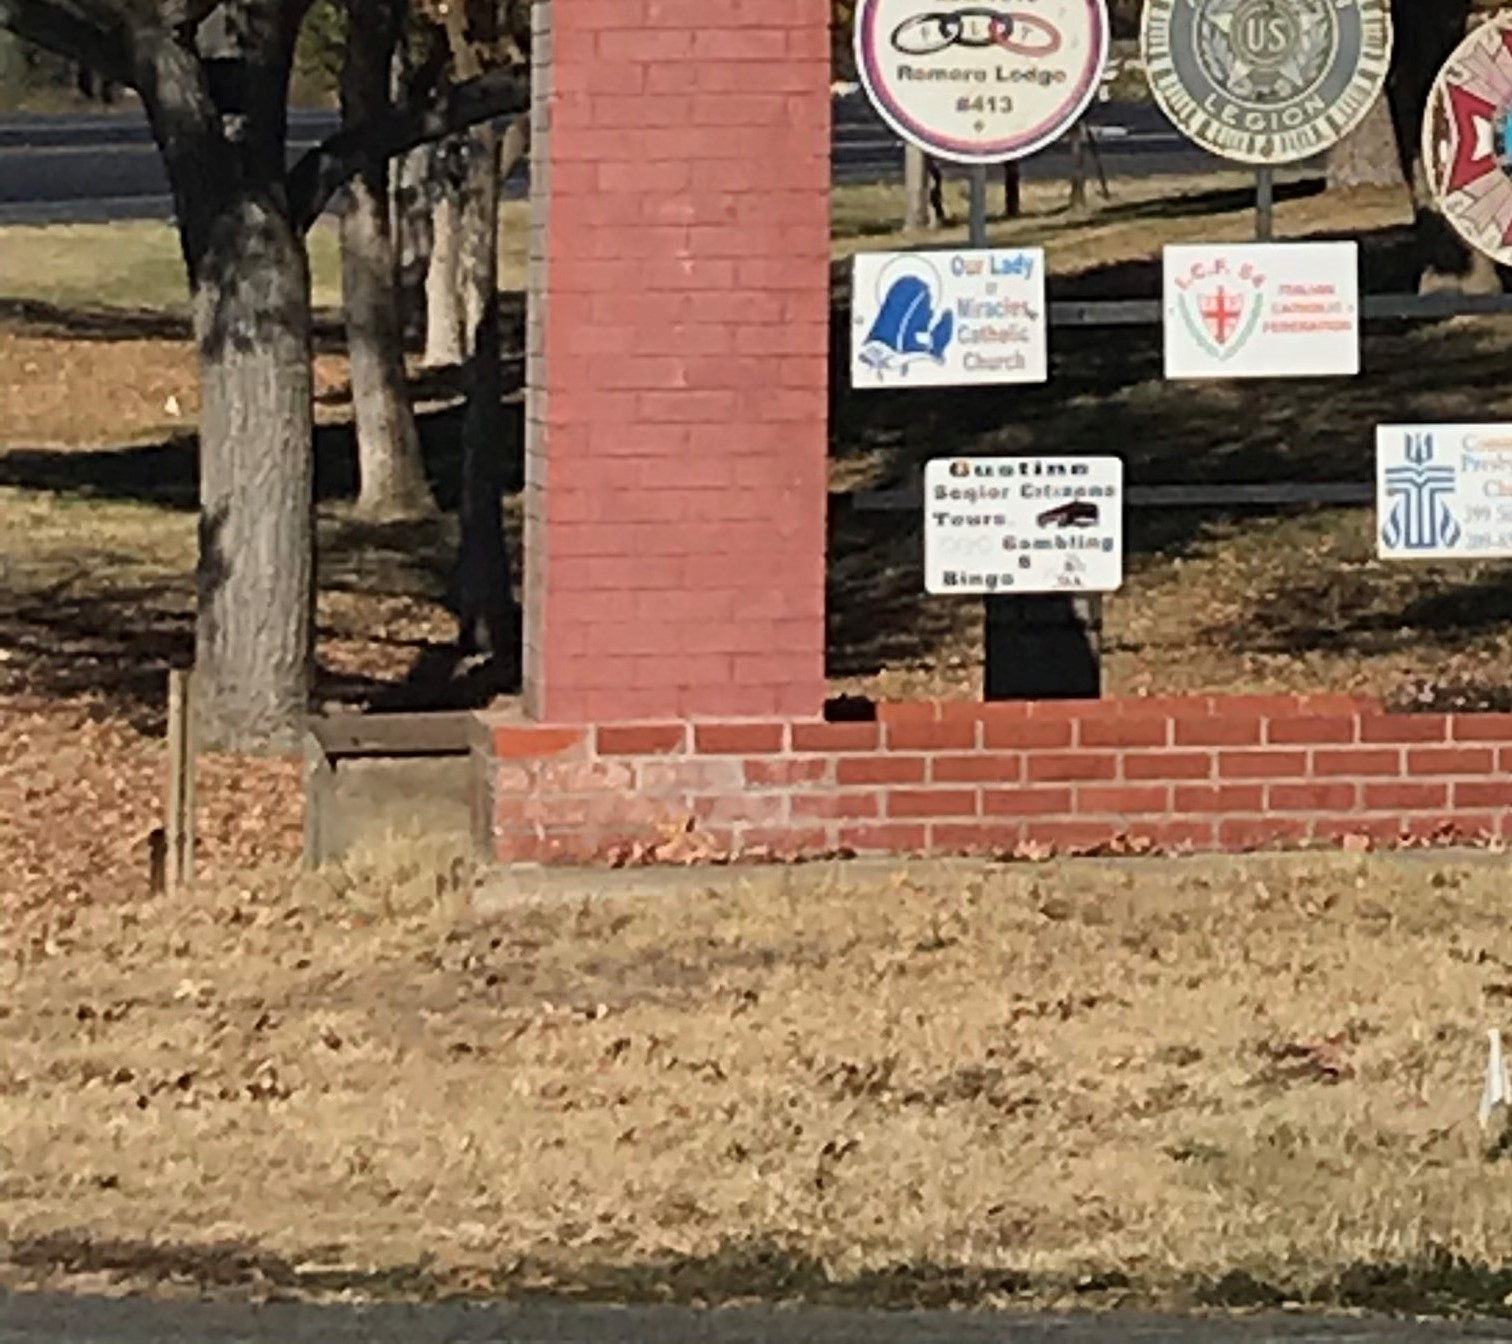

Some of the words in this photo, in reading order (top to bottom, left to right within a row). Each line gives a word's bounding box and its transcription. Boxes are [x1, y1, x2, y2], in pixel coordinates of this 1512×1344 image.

[1246, 18, 1287, 53] US
[995, 64, 1067, 86] Lodge
[955, 96, 1014, 113] #413
[1203, 92, 1326, 130] LEGION
[949, 461, 1090, 477] Gustine
[934, 484, 1010, 501] Senior
[1002, 533, 1115, 553] Gambling
[942, 570, 1015, 591] Bingo
